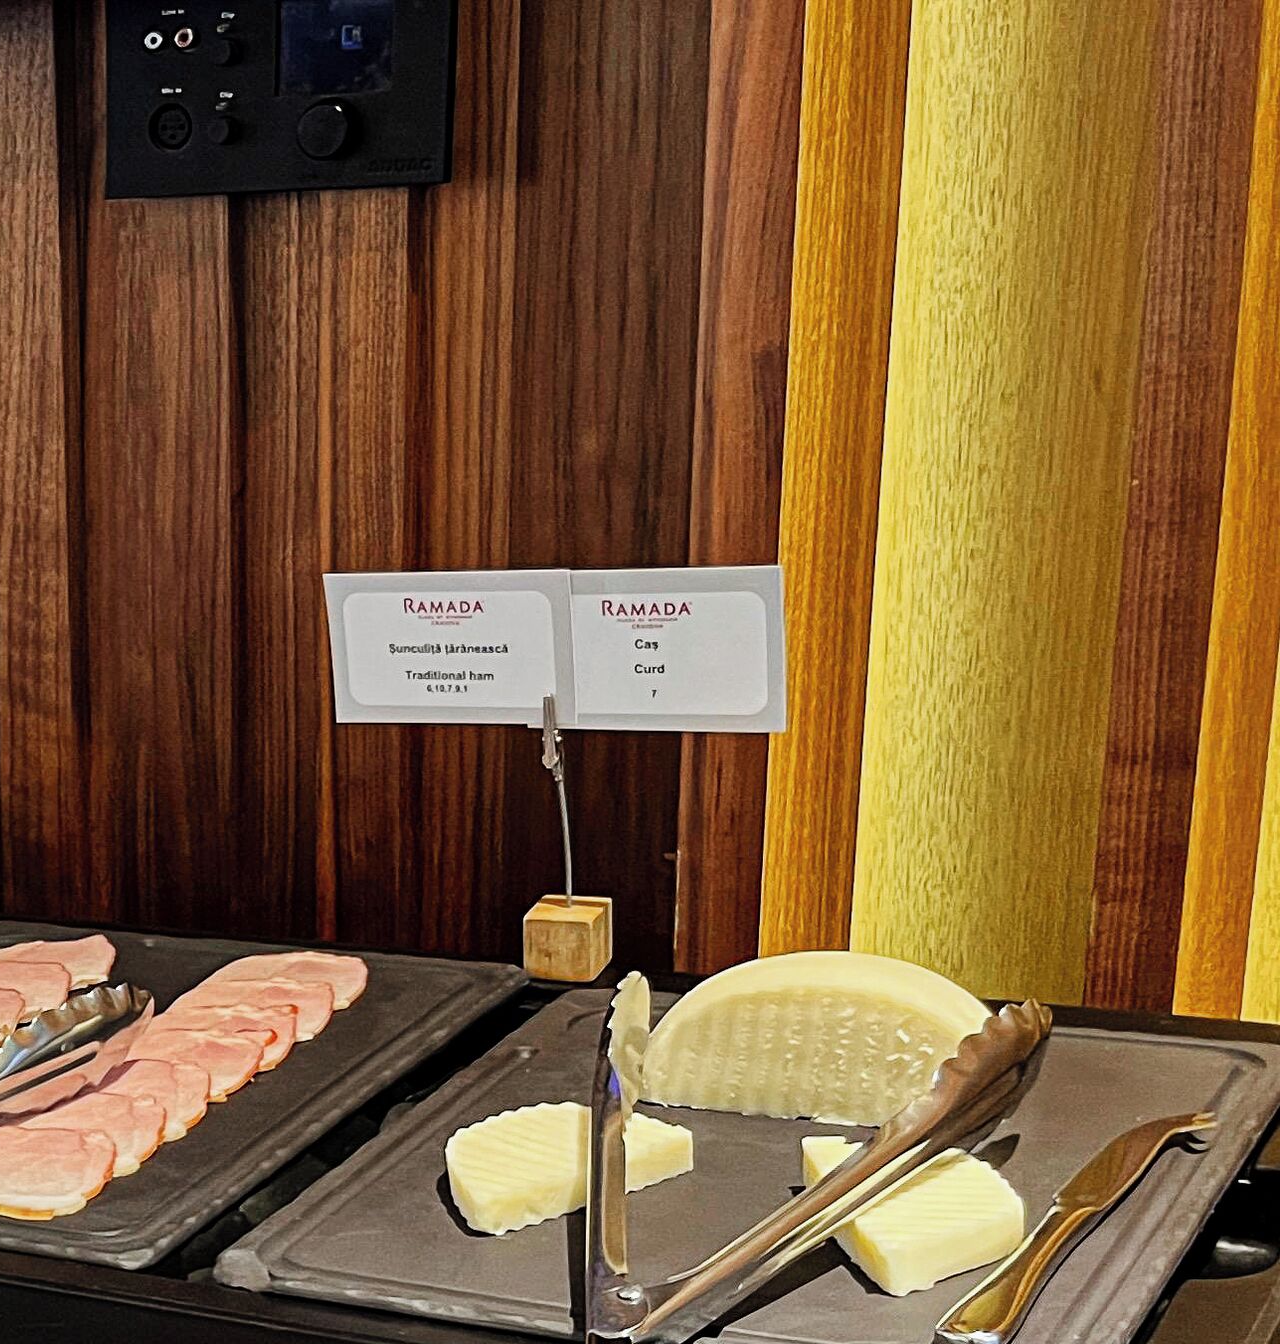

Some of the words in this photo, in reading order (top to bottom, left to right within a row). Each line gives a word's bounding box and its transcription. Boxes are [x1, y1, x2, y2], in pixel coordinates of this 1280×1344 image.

[403, 598, 484, 614] RAMADA
[601, 600, 691, 617] RAMADA
[634, 664, 665, 674] Curd
[405, 671, 466, 681] Traditional
[469, 671, 495, 681] ham
